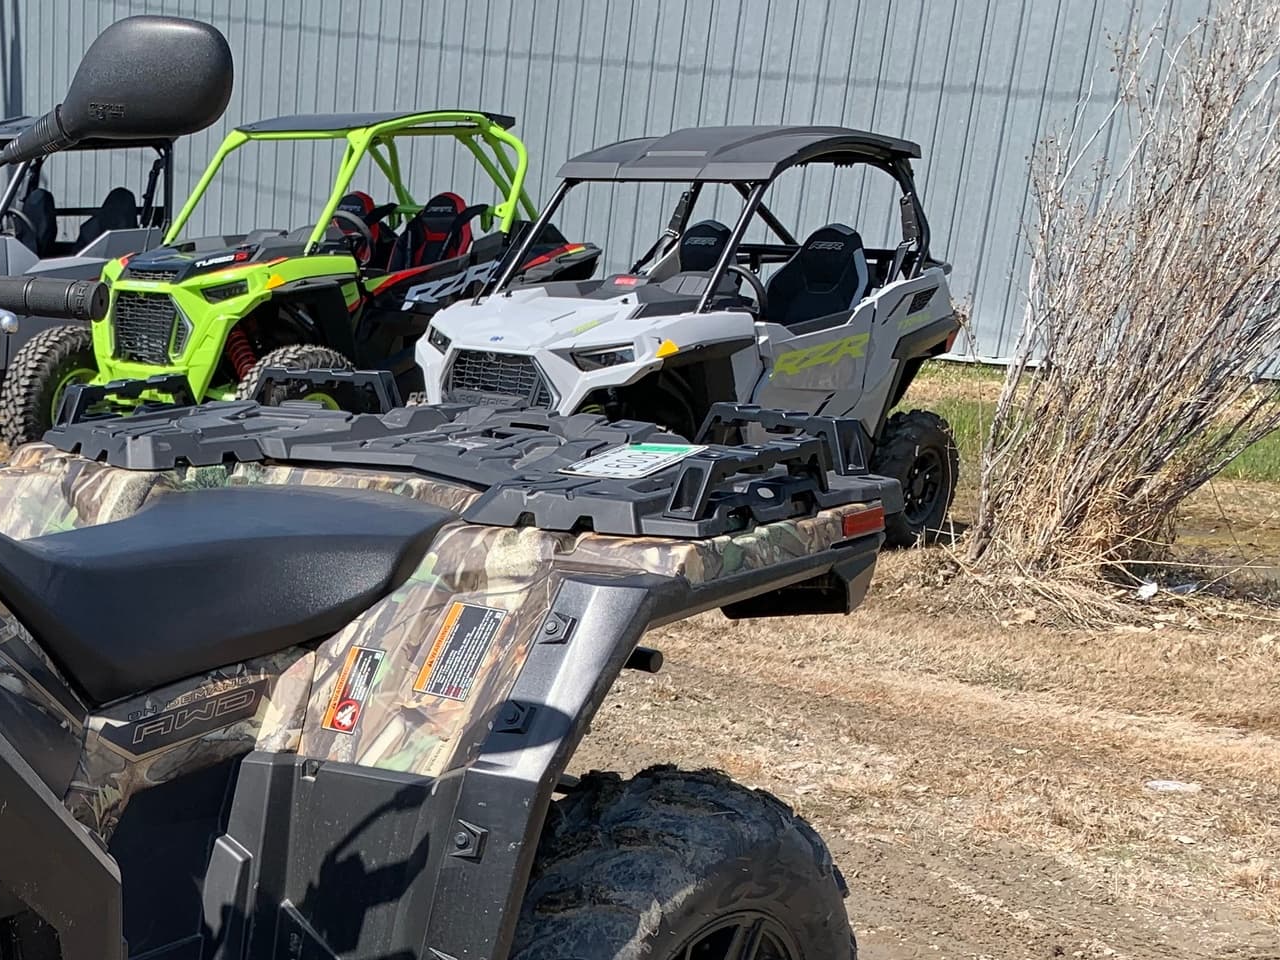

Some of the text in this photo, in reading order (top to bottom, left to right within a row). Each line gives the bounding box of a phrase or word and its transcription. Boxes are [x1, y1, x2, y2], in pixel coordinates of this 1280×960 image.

[194, 255, 235, 268] TURBO
[808, 240, 846, 251] RZR
[401, 259, 501, 311] RZR
[768, 333, 870, 382] RZR
[127, 704, 158, 721] ON
[132, 688, 256, 745] AWD
